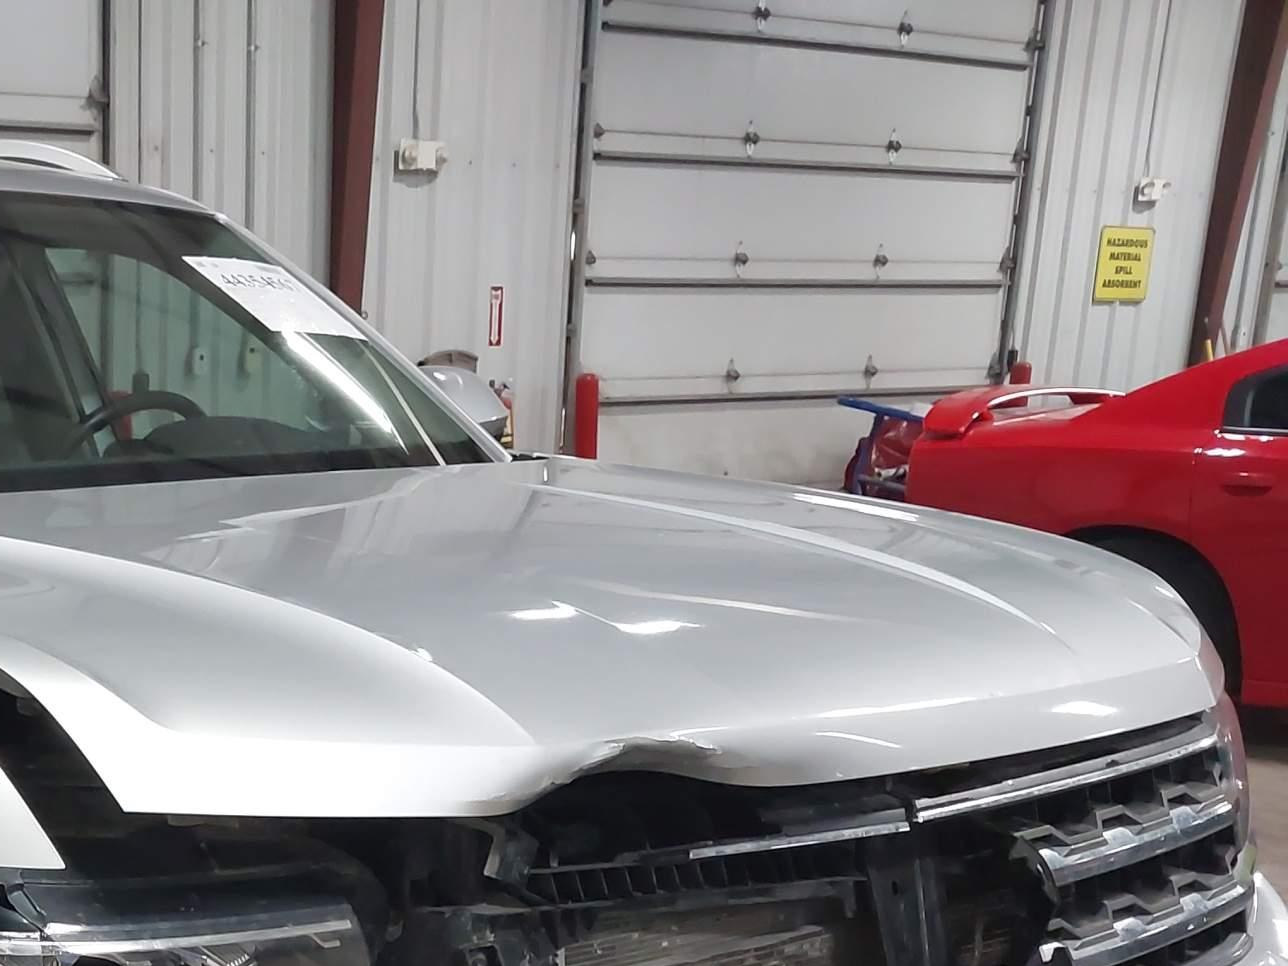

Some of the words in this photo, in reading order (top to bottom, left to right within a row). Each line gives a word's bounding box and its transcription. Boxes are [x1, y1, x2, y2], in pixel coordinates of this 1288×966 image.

[1107, 238, 1148, 248] HAZARDOUS
[1109, 252, 1142, 262] MATERIAL
[1115, 266, 1133, 275] SPILL
[1102, 279, 1142, 289] ABSORBENT
